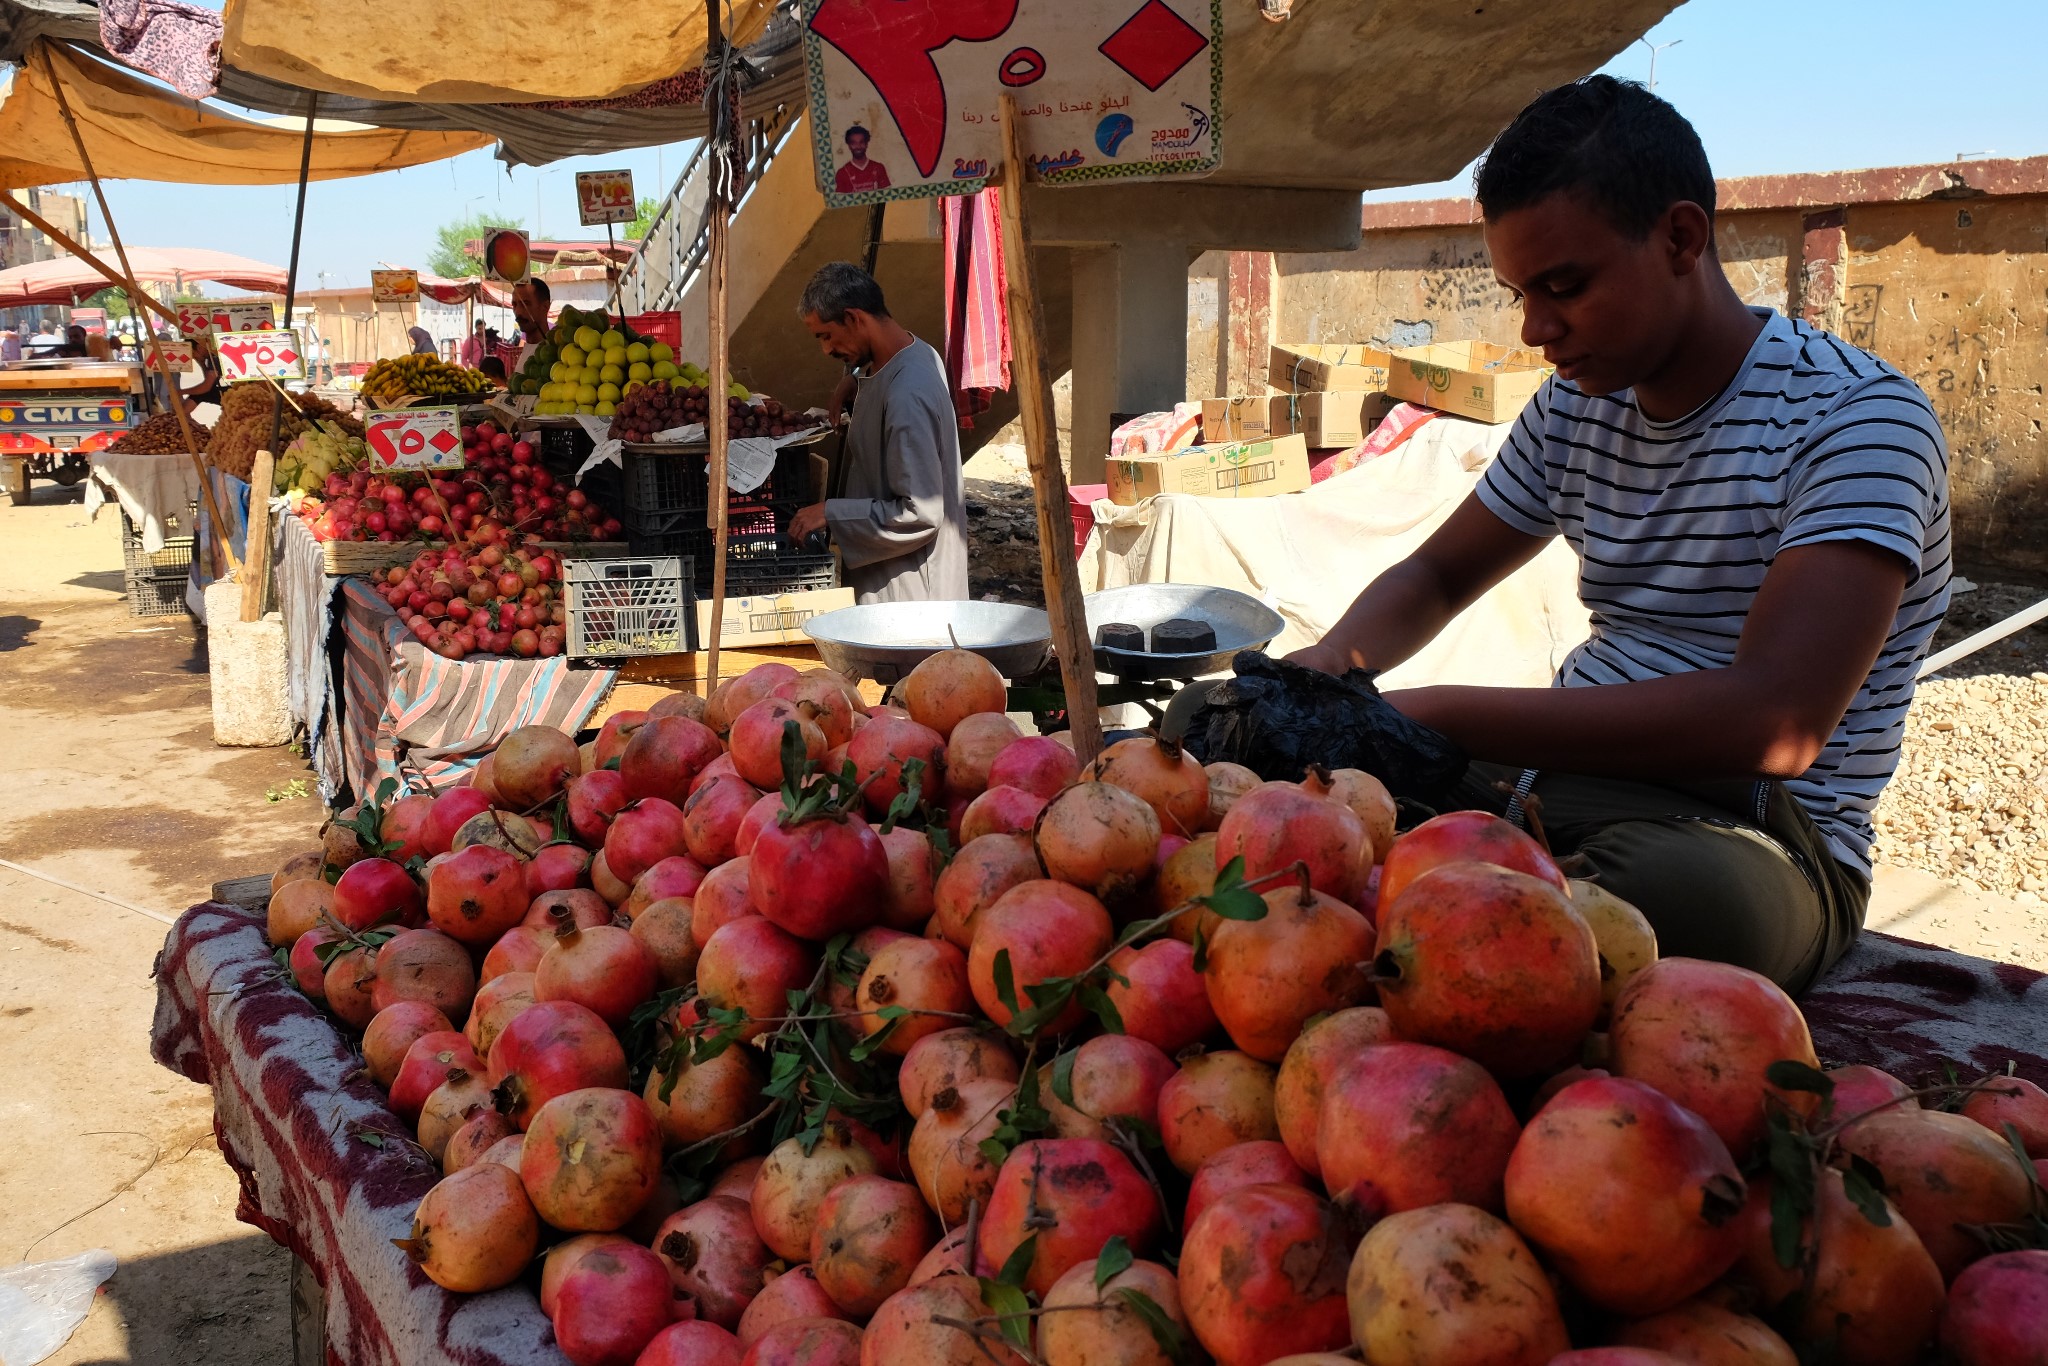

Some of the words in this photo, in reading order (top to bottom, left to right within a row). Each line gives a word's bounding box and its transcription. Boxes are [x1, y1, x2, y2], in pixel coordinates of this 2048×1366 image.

[218, 340, 299, 376] ٣٥٠
[23, 407, 100, 422] CMG
[366, 419, 460, 468] ٢٥٠
